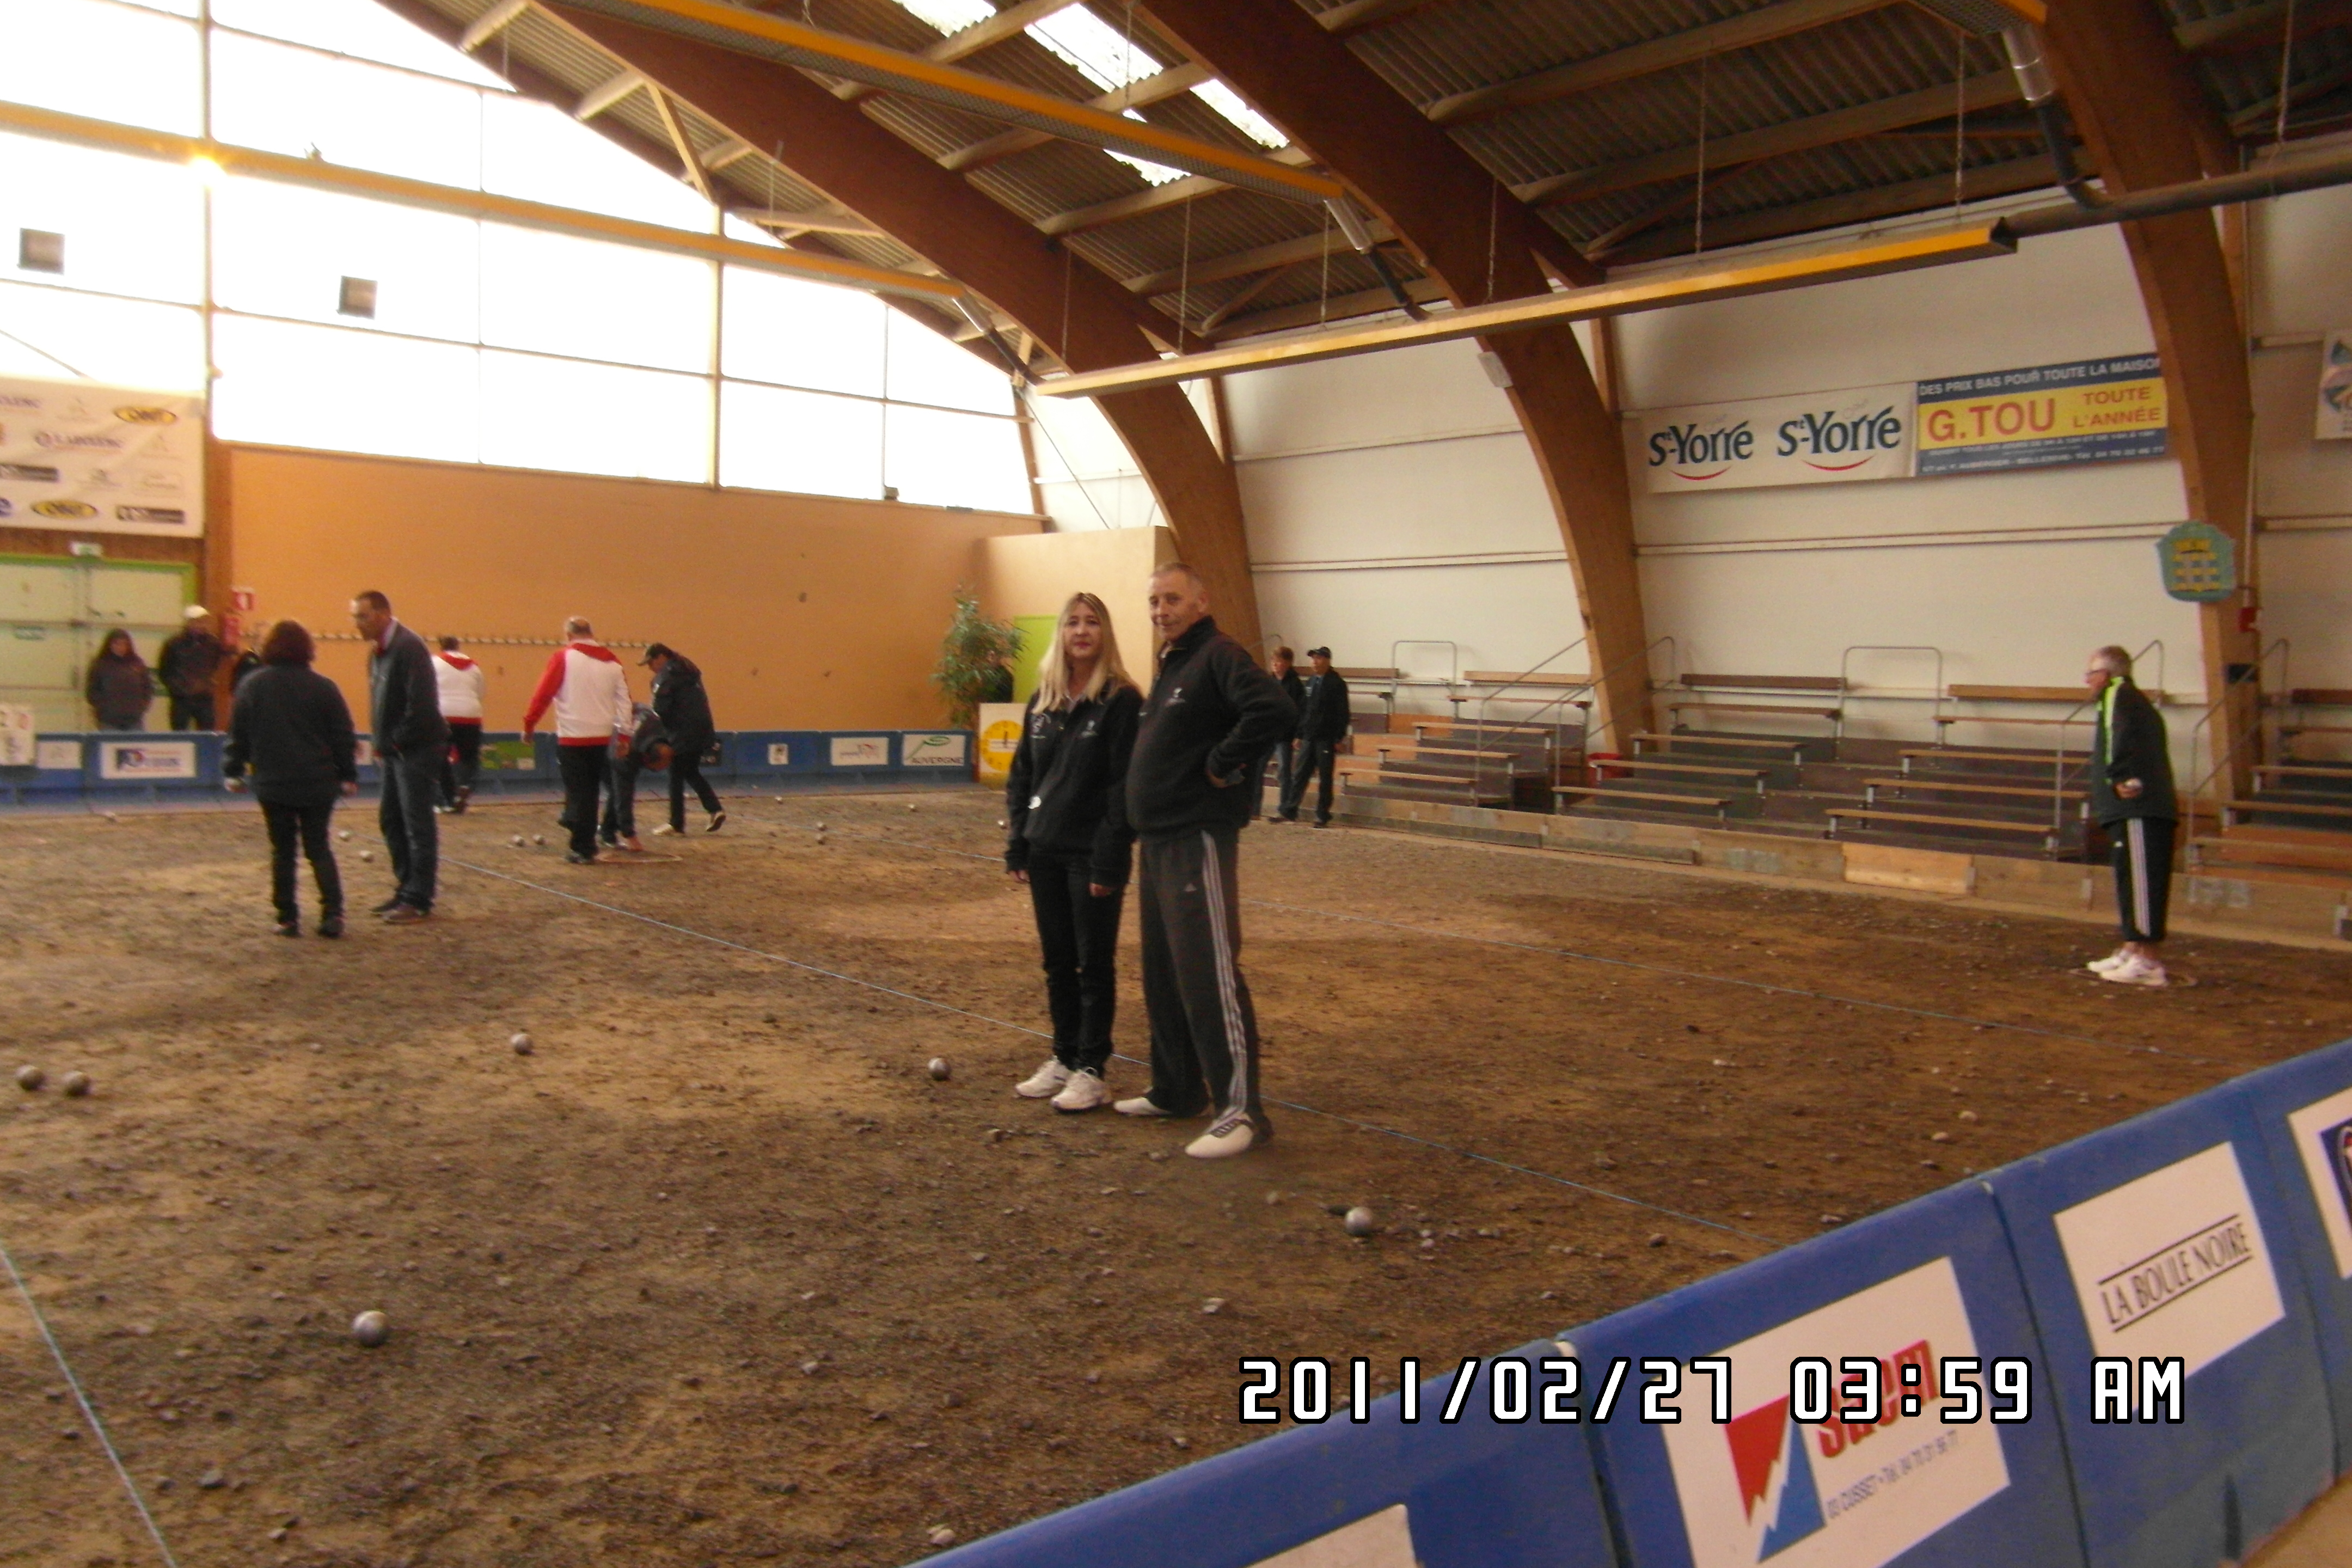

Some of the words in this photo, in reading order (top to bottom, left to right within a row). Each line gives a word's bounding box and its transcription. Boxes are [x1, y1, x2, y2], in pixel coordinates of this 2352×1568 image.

[1919, 383, 1943, 396] DES
[1945, 380, 1973, 393] PRIX
[1975, 376, 2002, 389] BAS
[2004, 370, 2041, 385] POUR
[2043, 365, 2086, 381] TOUTE
[2088, 364, 2108, 376] LA
[2081, 387, 2151, 405] TOUTE
[1926, 397, 2056, 442] G.TOU
[2072, 406, 2161, 427] L'ANNÉE
[910, 756, 963, 765] AUVERGNE
[2100, 1284, 2133, 1324] LA
[2129, 1250, 2193, 1308] BOULE
[2191, 1221, 2250, 1271] NOIRE
